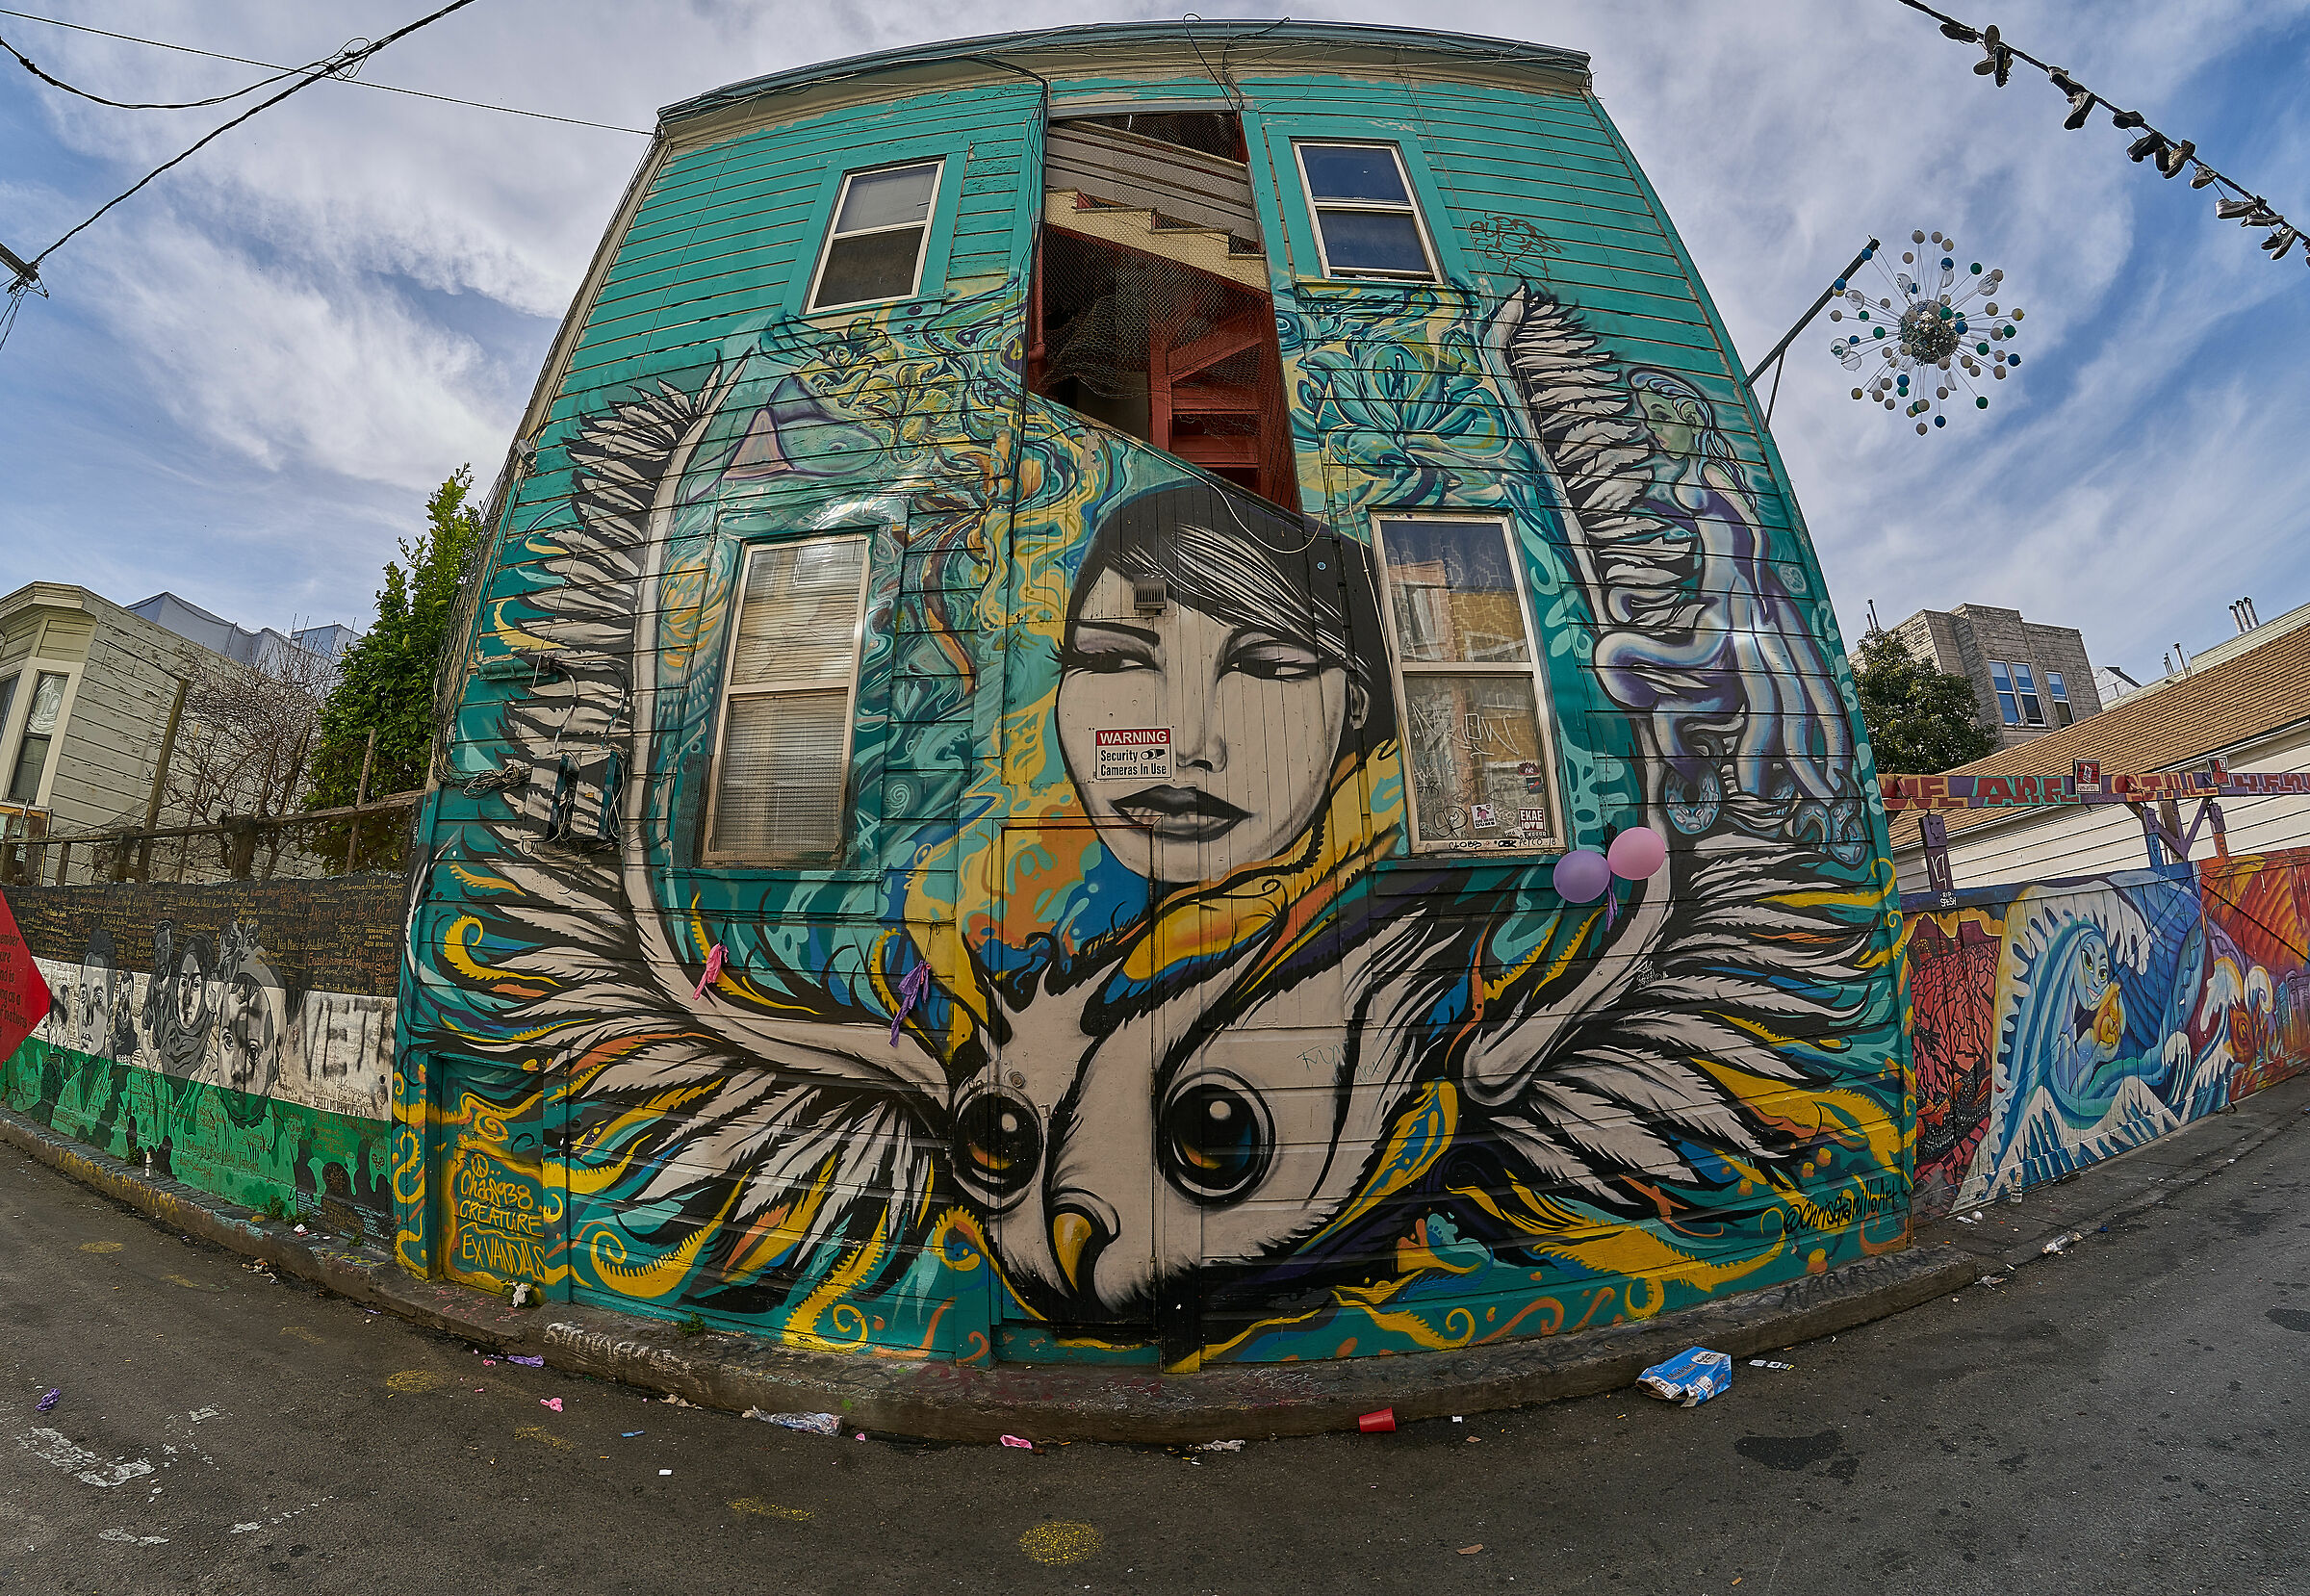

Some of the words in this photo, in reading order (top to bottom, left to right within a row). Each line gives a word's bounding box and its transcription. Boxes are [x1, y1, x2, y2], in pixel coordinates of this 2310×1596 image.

[1099, 731, 1168, 745] WARNING
[1100, 749, 1139, 763] Security
[1100, 763, 1138, 777] Cameras
[1140, 763, 1149, 775] In
[1150, 761, 1167, 774] Use
[1520, 810, 1543, 821] EKAE
[459, 1199, 544, 1238] CREATURE
